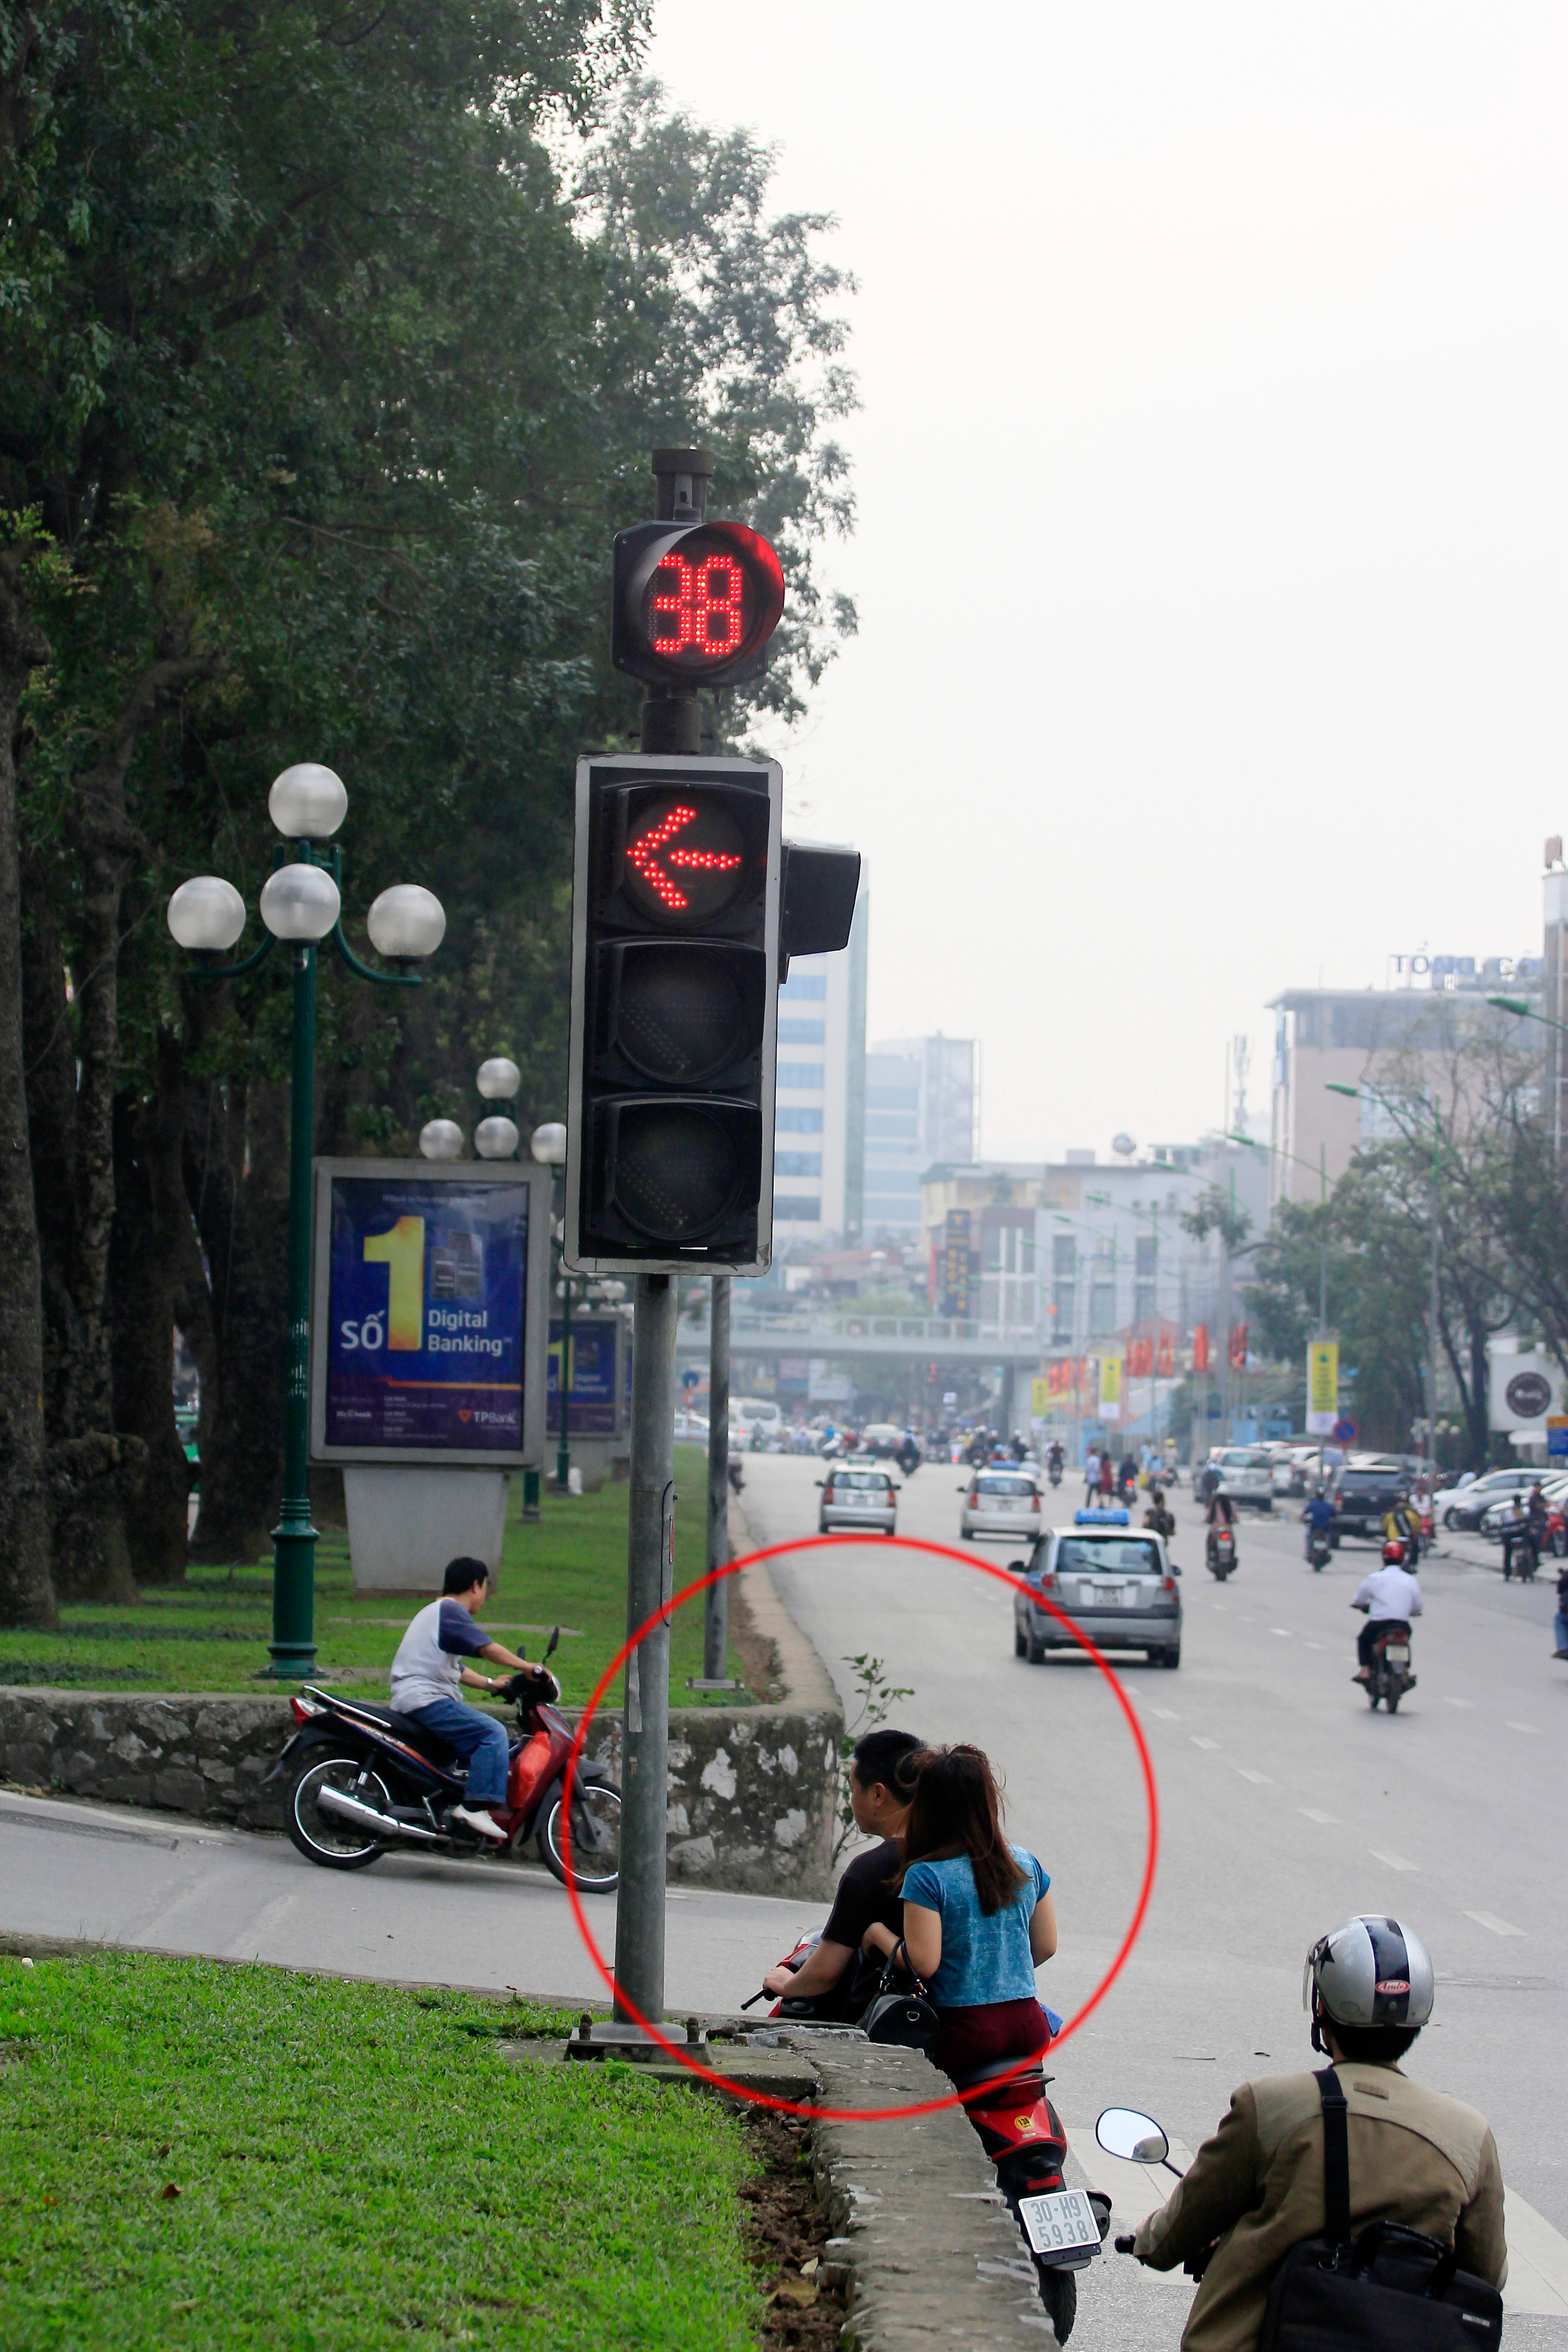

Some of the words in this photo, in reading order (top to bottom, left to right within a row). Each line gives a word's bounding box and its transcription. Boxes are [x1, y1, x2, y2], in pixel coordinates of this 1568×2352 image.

[655, 554, 742, 655] 38
[363, 1215, 425, 1350] 1
[428, 1310, 488, 1331] Digital
[428, 1334, 504, 1357] Banking
[473, 1411, 517, 1424] TPBank
[1031, 2195, 1081, 2223] 30-H9
[1038, 2220, 1089, 2247] 5938
